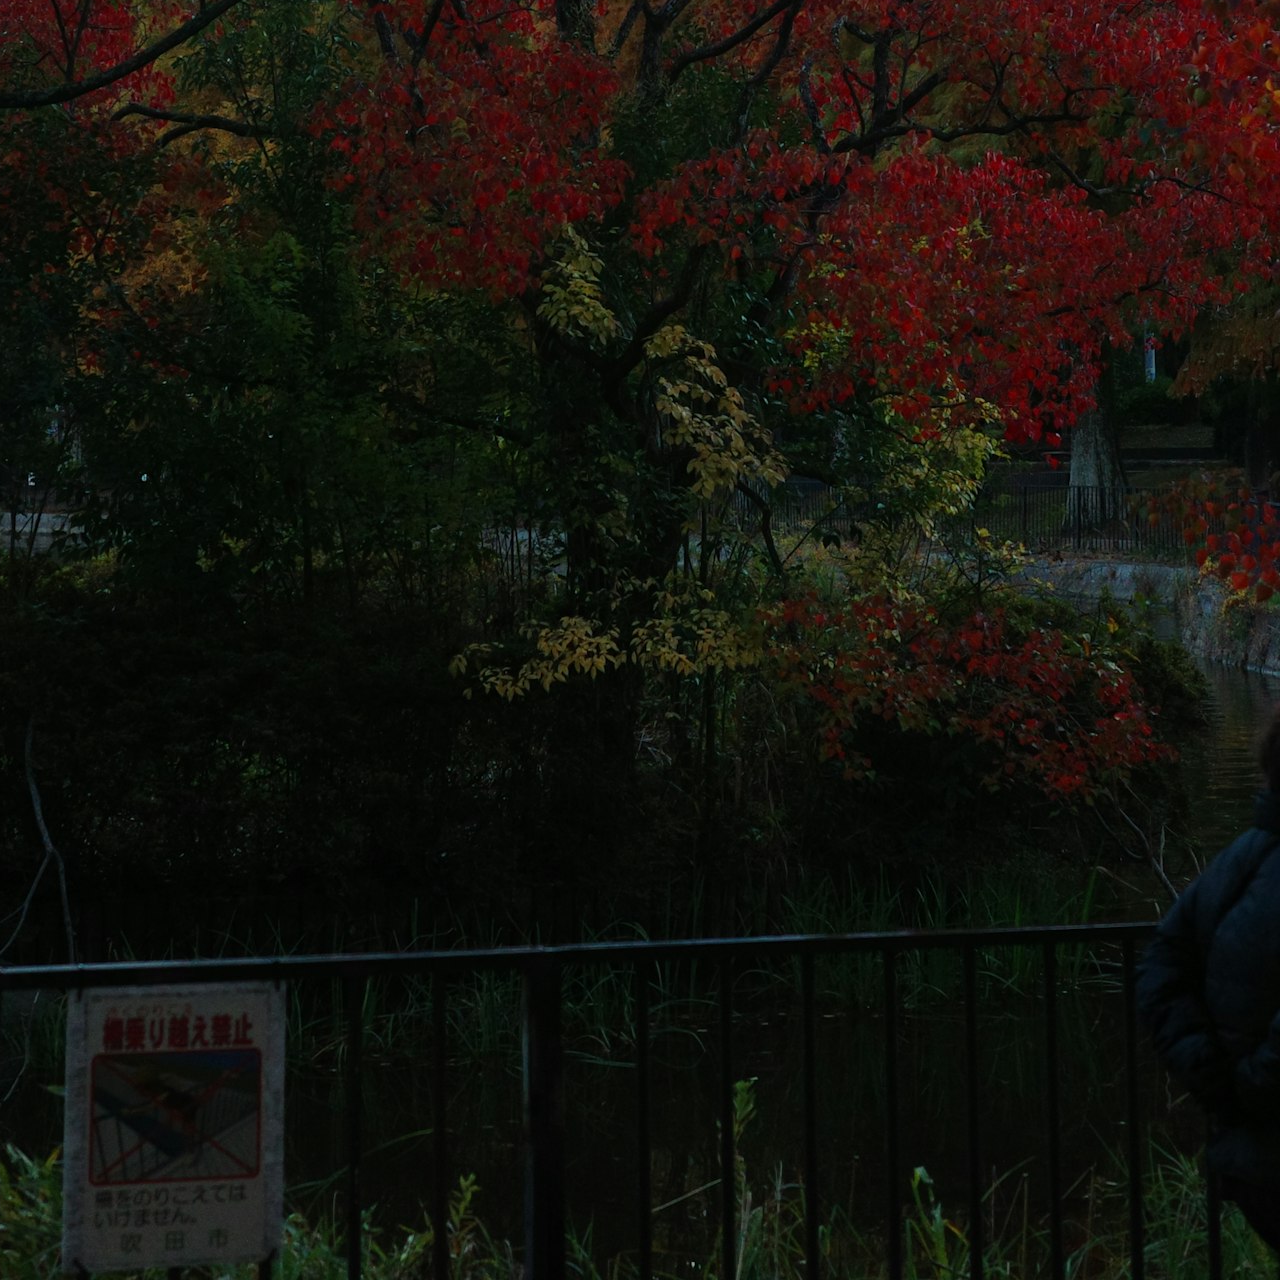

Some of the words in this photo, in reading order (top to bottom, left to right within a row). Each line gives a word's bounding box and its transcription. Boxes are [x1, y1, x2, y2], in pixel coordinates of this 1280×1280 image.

[103, 1012, 253, 1051] 柵乗り越え禁止
